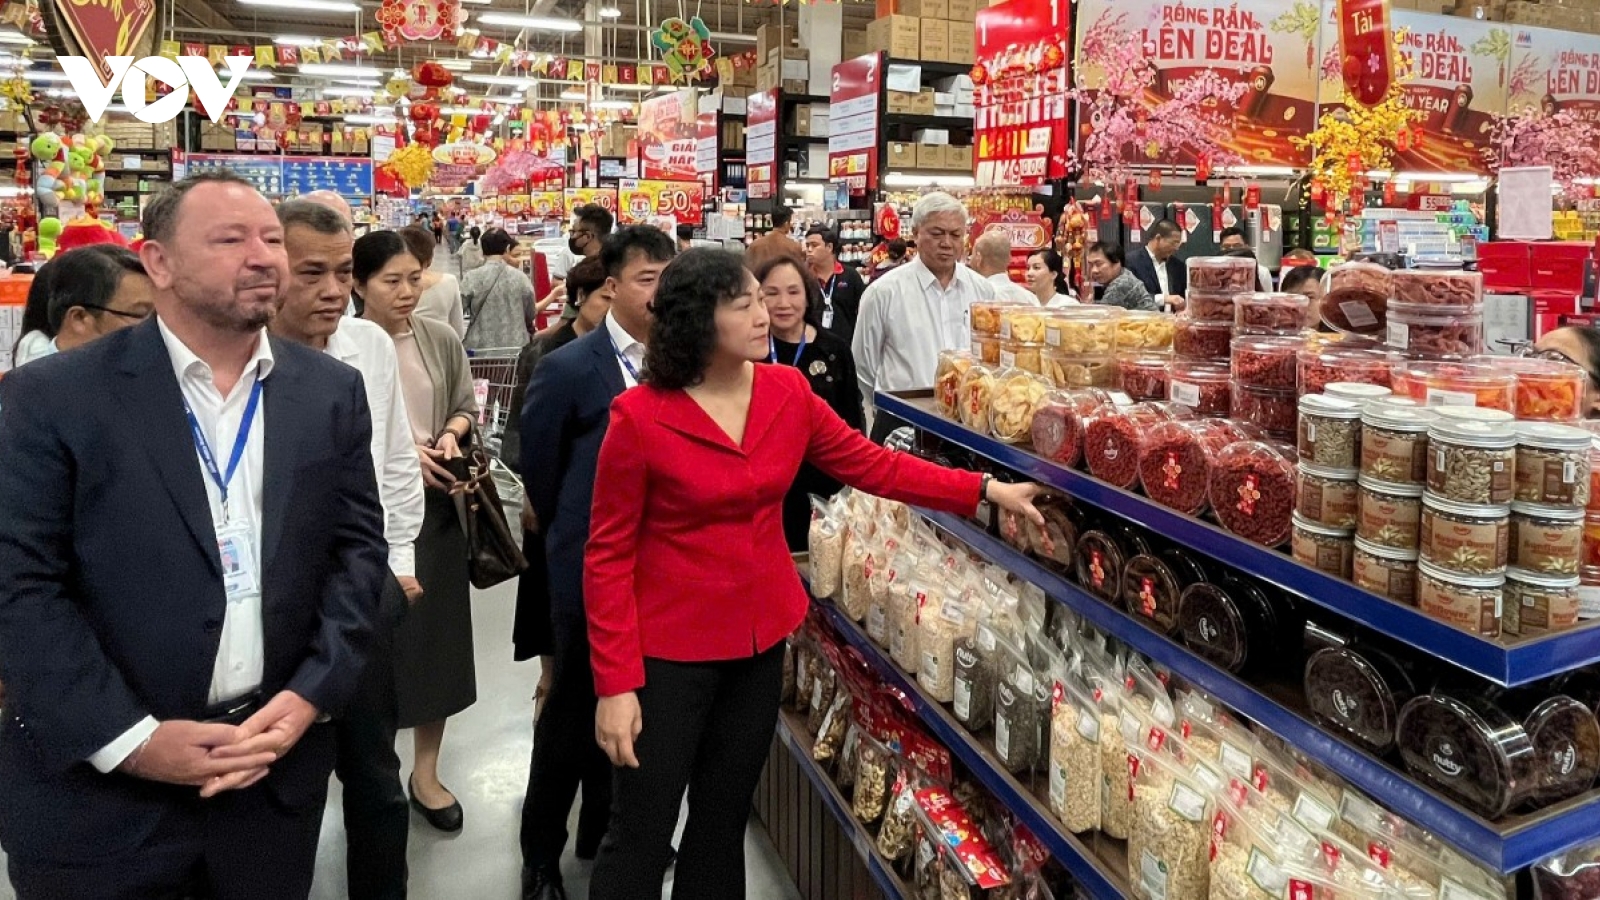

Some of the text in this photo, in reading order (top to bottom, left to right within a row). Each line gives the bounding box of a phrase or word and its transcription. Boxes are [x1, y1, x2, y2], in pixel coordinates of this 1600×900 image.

[1351, 8, 1373, 36] Tài
[1141, 22, 1273, 65] LÊN DEAL
[1422, 51, 1472, 84] DEAL
[832, 71, 841, 92] 2
[1418, 95, 1450, 114] YEAR
[658, 190, 688, 212] 50
[1433, 753, 1464, 776] nutty
